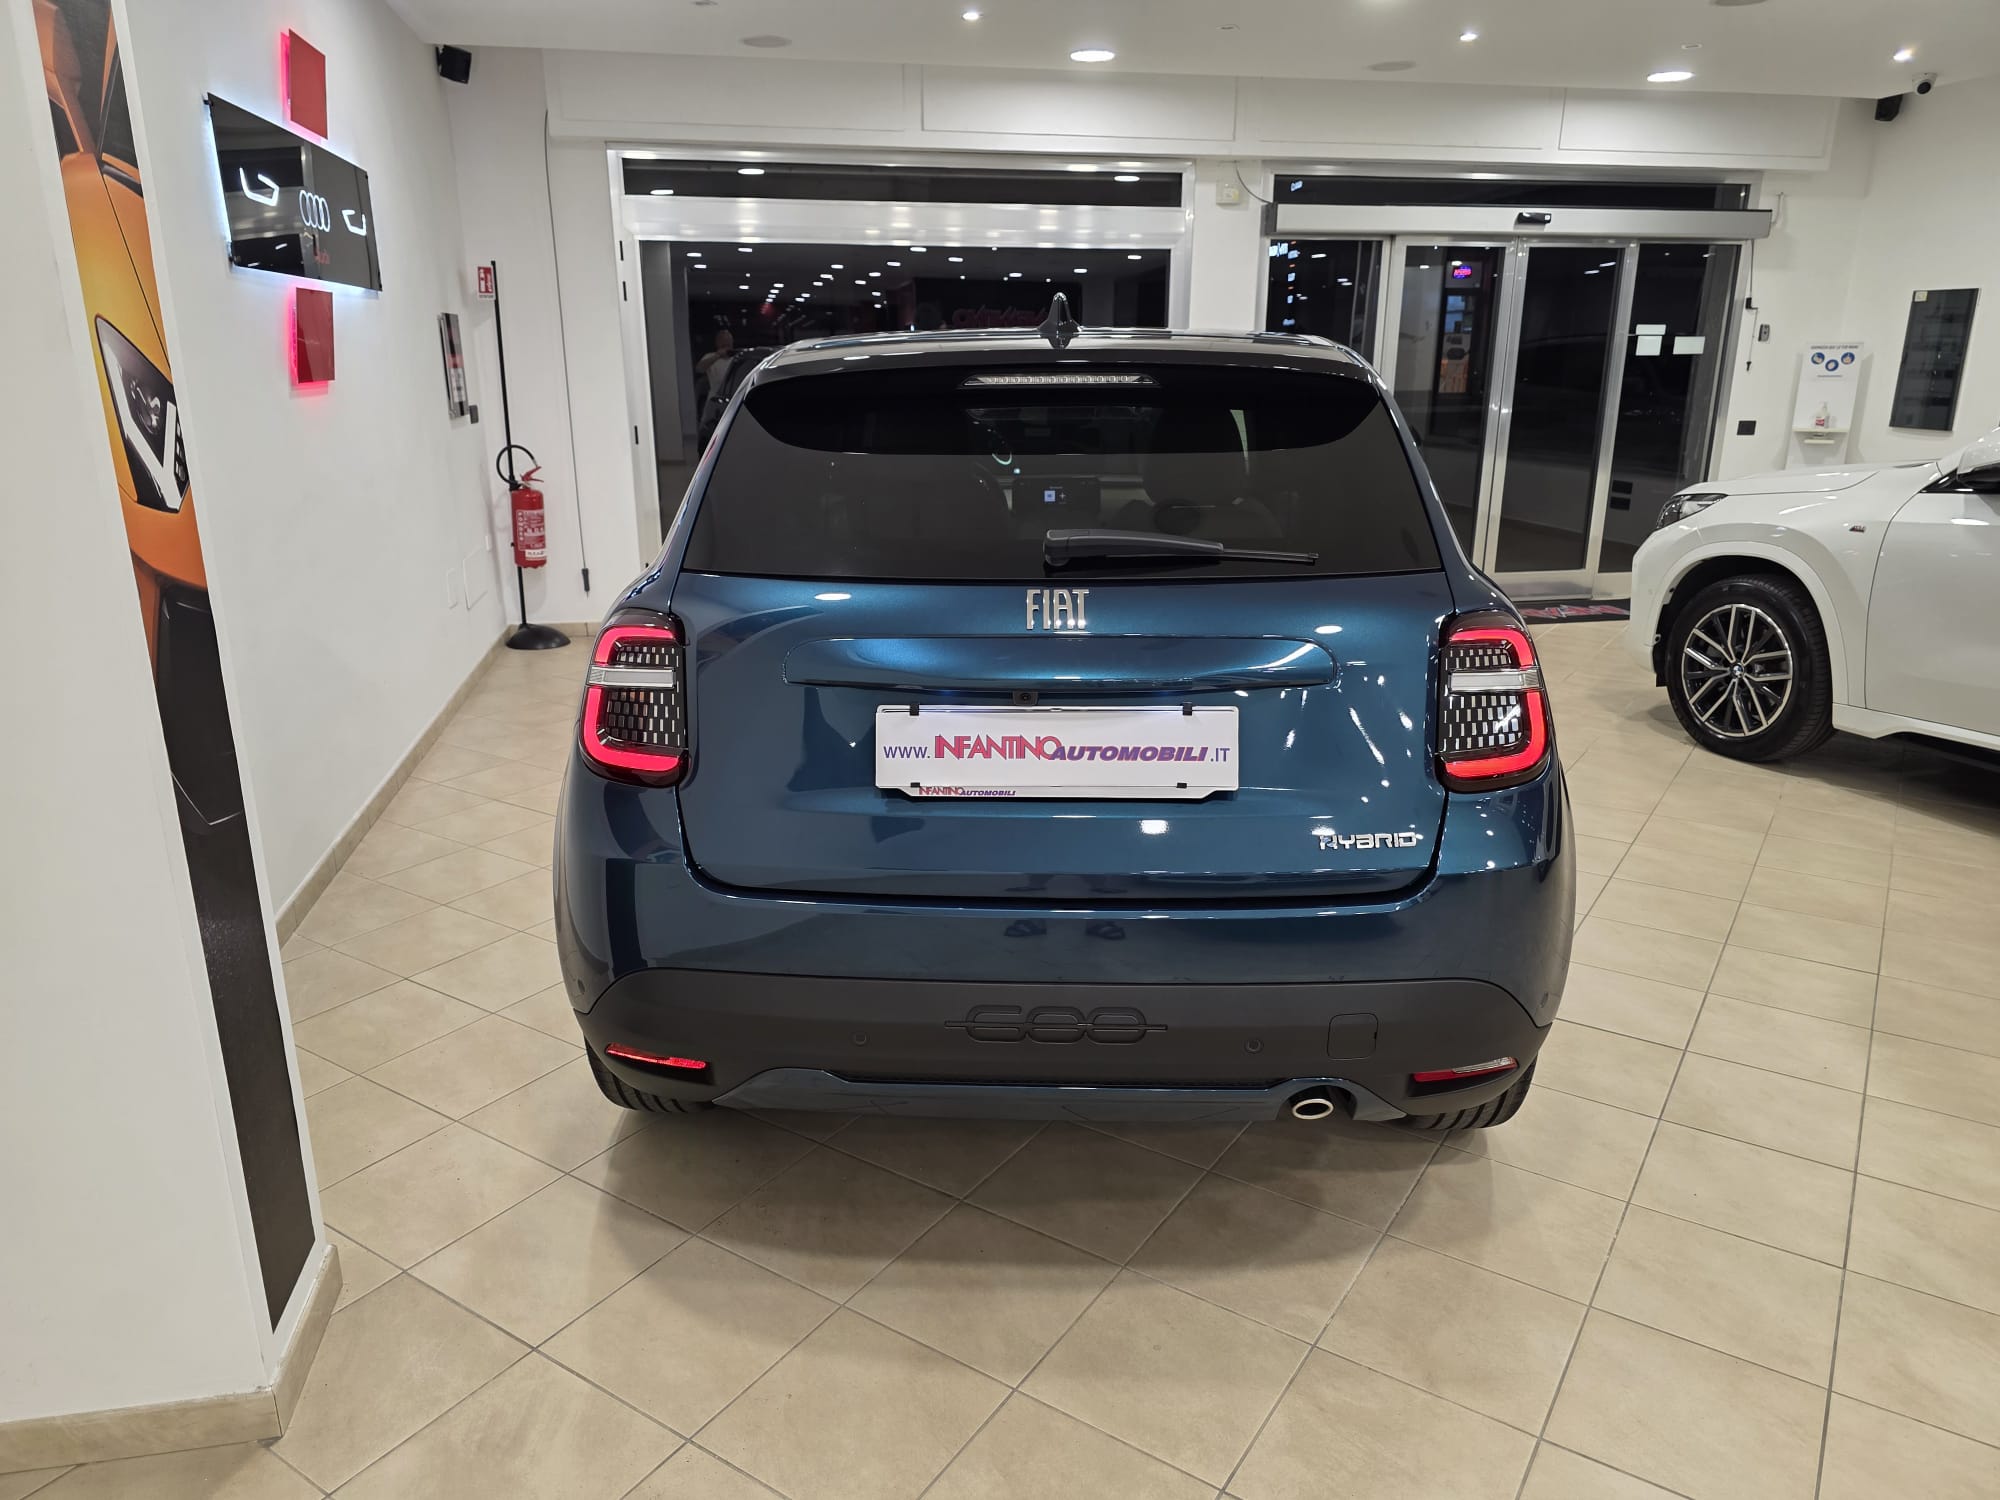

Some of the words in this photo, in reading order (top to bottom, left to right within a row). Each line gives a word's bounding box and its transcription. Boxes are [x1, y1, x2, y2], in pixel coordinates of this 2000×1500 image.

[1026, 589, 1090, 630] FIAT
[1319, 831, 1417, 850] HYBRID
[962, 1004, 1148, 1044] 600
